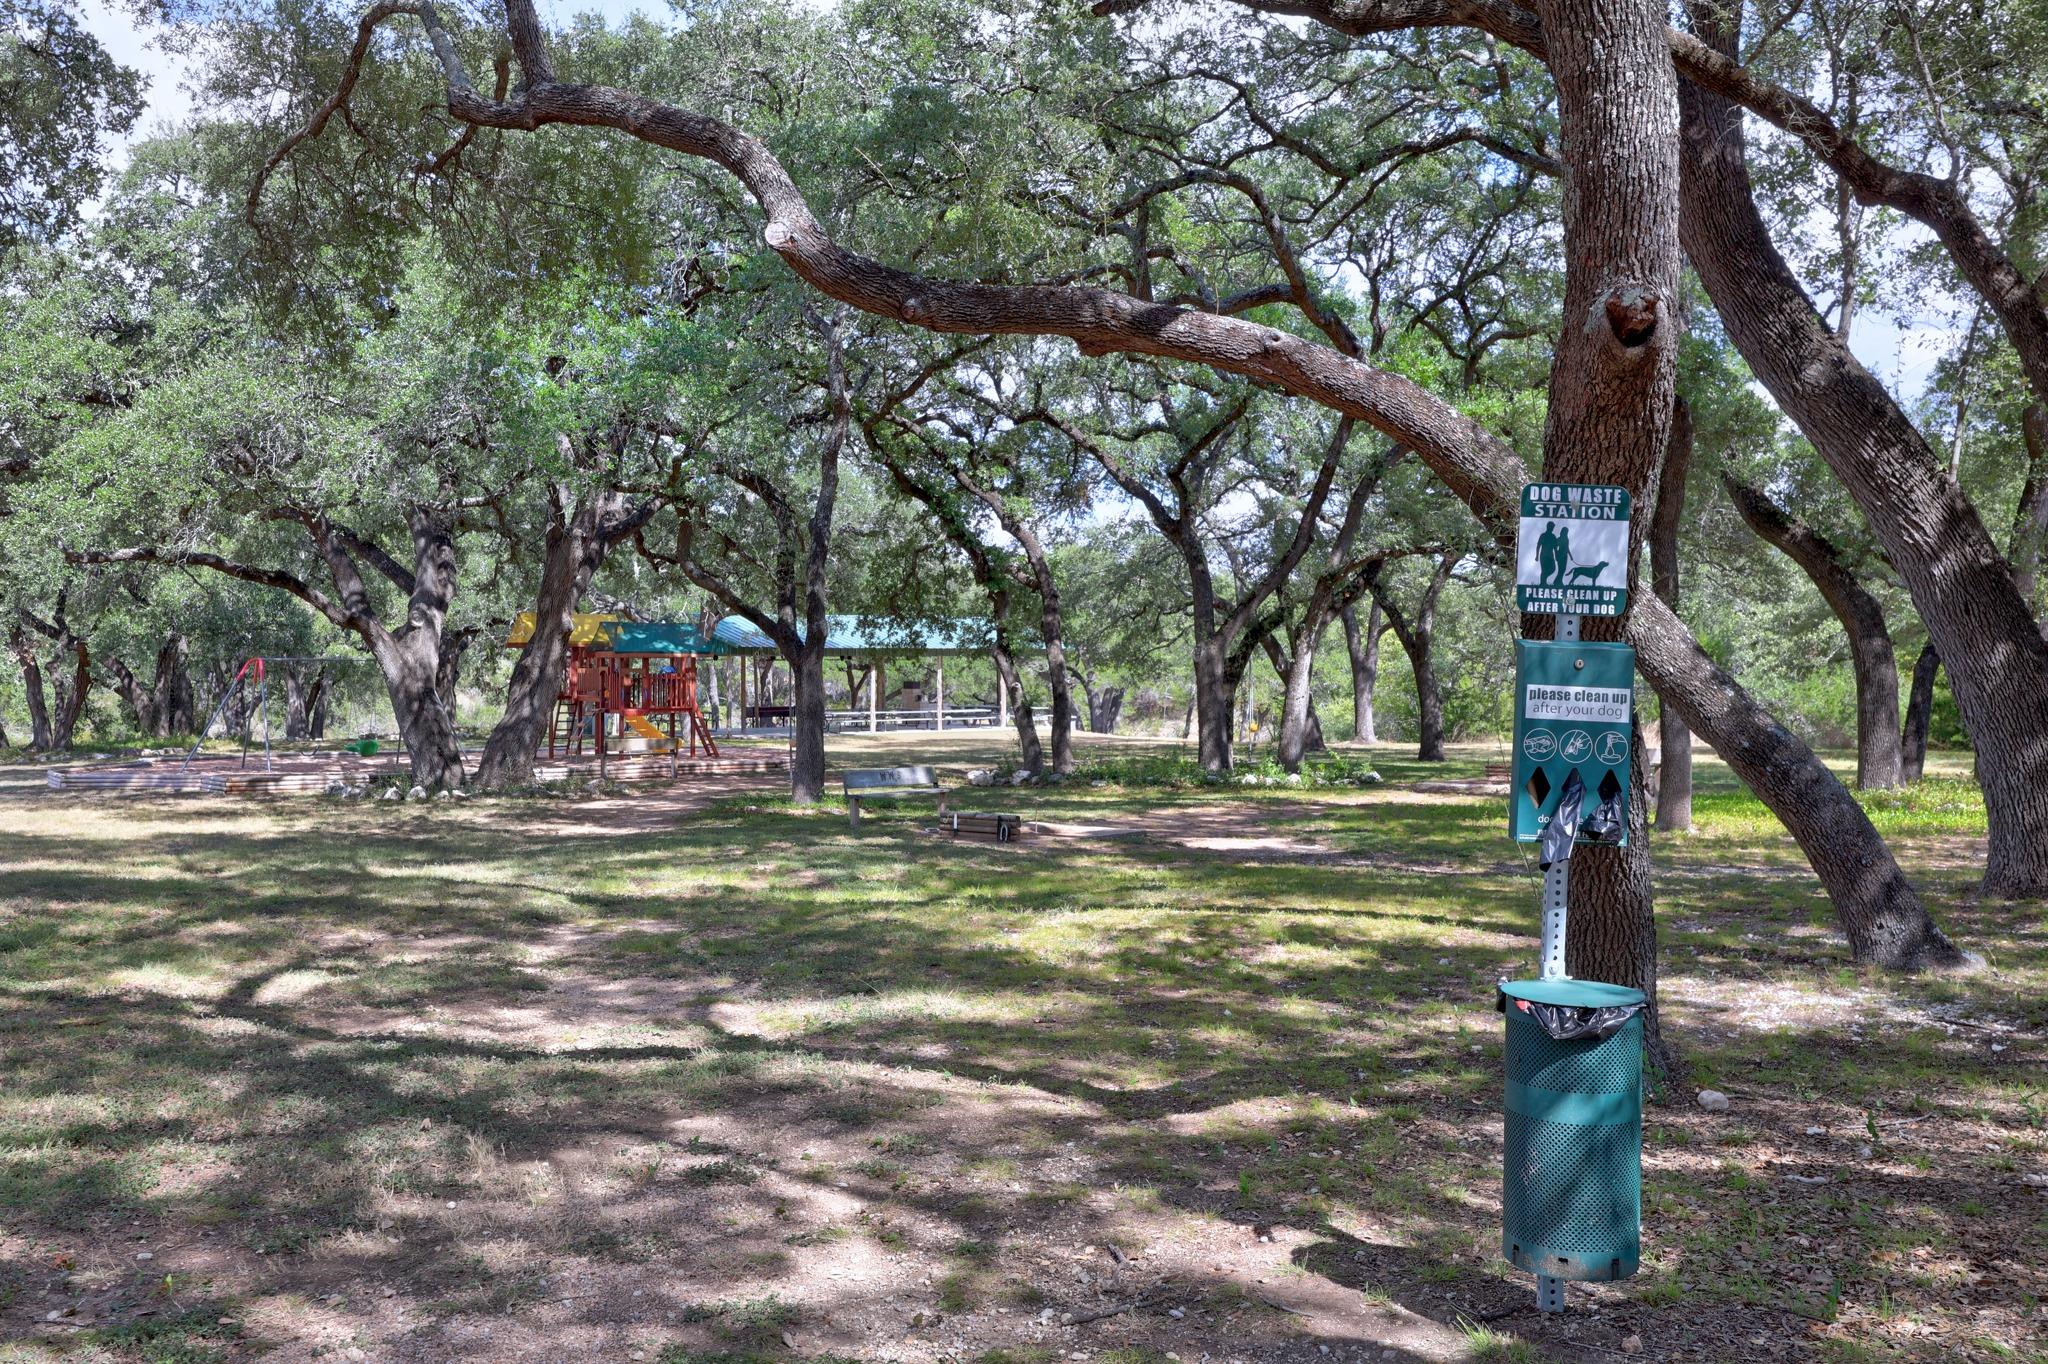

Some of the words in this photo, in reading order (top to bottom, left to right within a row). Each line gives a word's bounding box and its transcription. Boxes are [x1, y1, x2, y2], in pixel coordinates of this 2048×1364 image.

[1530, 486, 1562, 501] DOG
[1568, 487, 1622, 504] WASTE
[1535, 505, 1616, 519] STATION
[1525, 587, 1563, 599] PLEASE
[1566, 589, 1600, 601] CLEAN
[1603, 590, 1617, 601] UP
[1527, 602, 1558, 613] AFTER
[1562, 603, 1590, 614] YOUR
[1593, 604, 1615, 615] DOG
[1529, 687, 1571, 701] please
[1574, 689, 1609, 703] clean
[1612, 692, 1627, 705] up
[1533, 701, 1562, 714] after
[1566, 706, 1595, 716] your
[1597, 704, 1623, 719] dog
